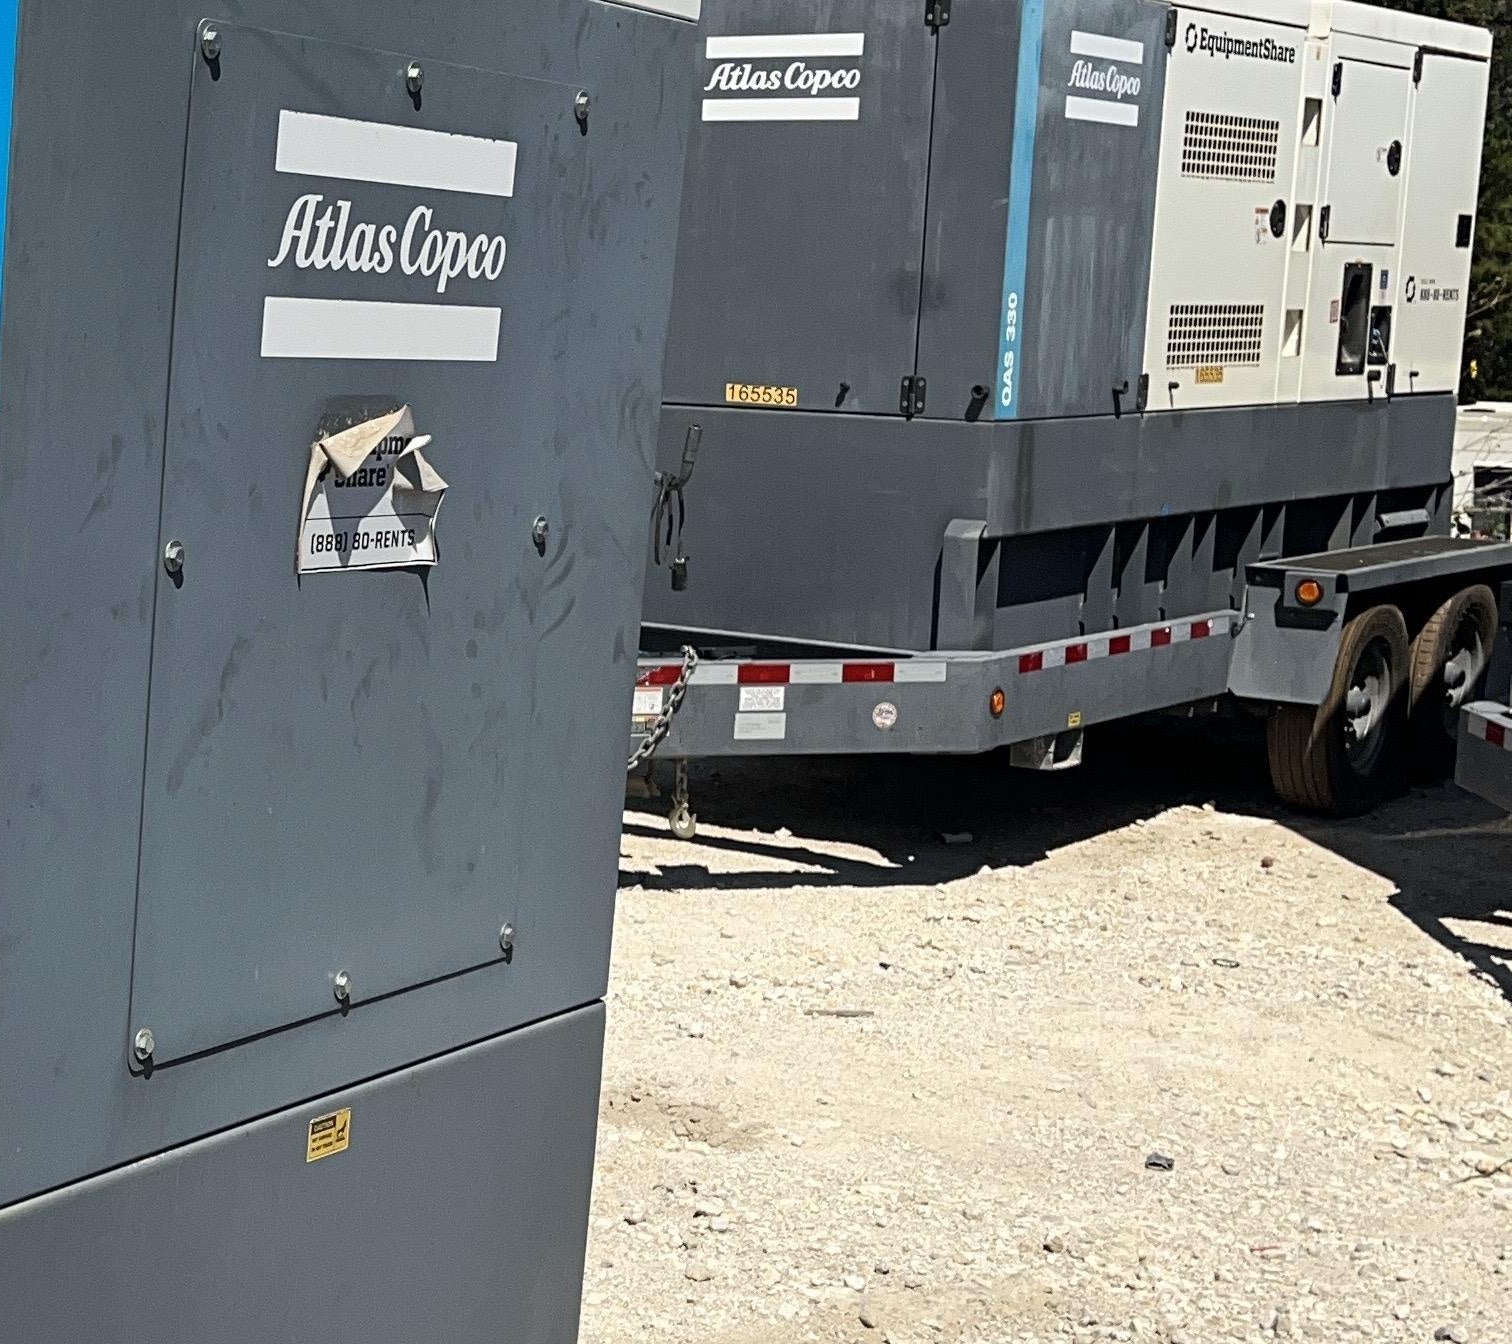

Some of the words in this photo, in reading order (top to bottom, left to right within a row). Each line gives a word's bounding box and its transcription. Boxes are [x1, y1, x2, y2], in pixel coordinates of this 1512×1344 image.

[1199, 27, 1296, 64] EquipmentShare
[704, 63, 783, 92] Atlas
[783, 61, 861, 96] Copco
[1067, 59, 1106, 92] Atlas
[1105, 65, 1141, 99] Copco
[267, 193, 397, 274] Atlas
[399, 204, 507, 293] Copco
[1005, 292, 1018, 342] 330
[728, 384, 795, 405] 165535
[1001, 350, 1014, 407] QAS
[310, 531, 348, 555] (888)
[352, 529, 416, 551] 80-RENTS
